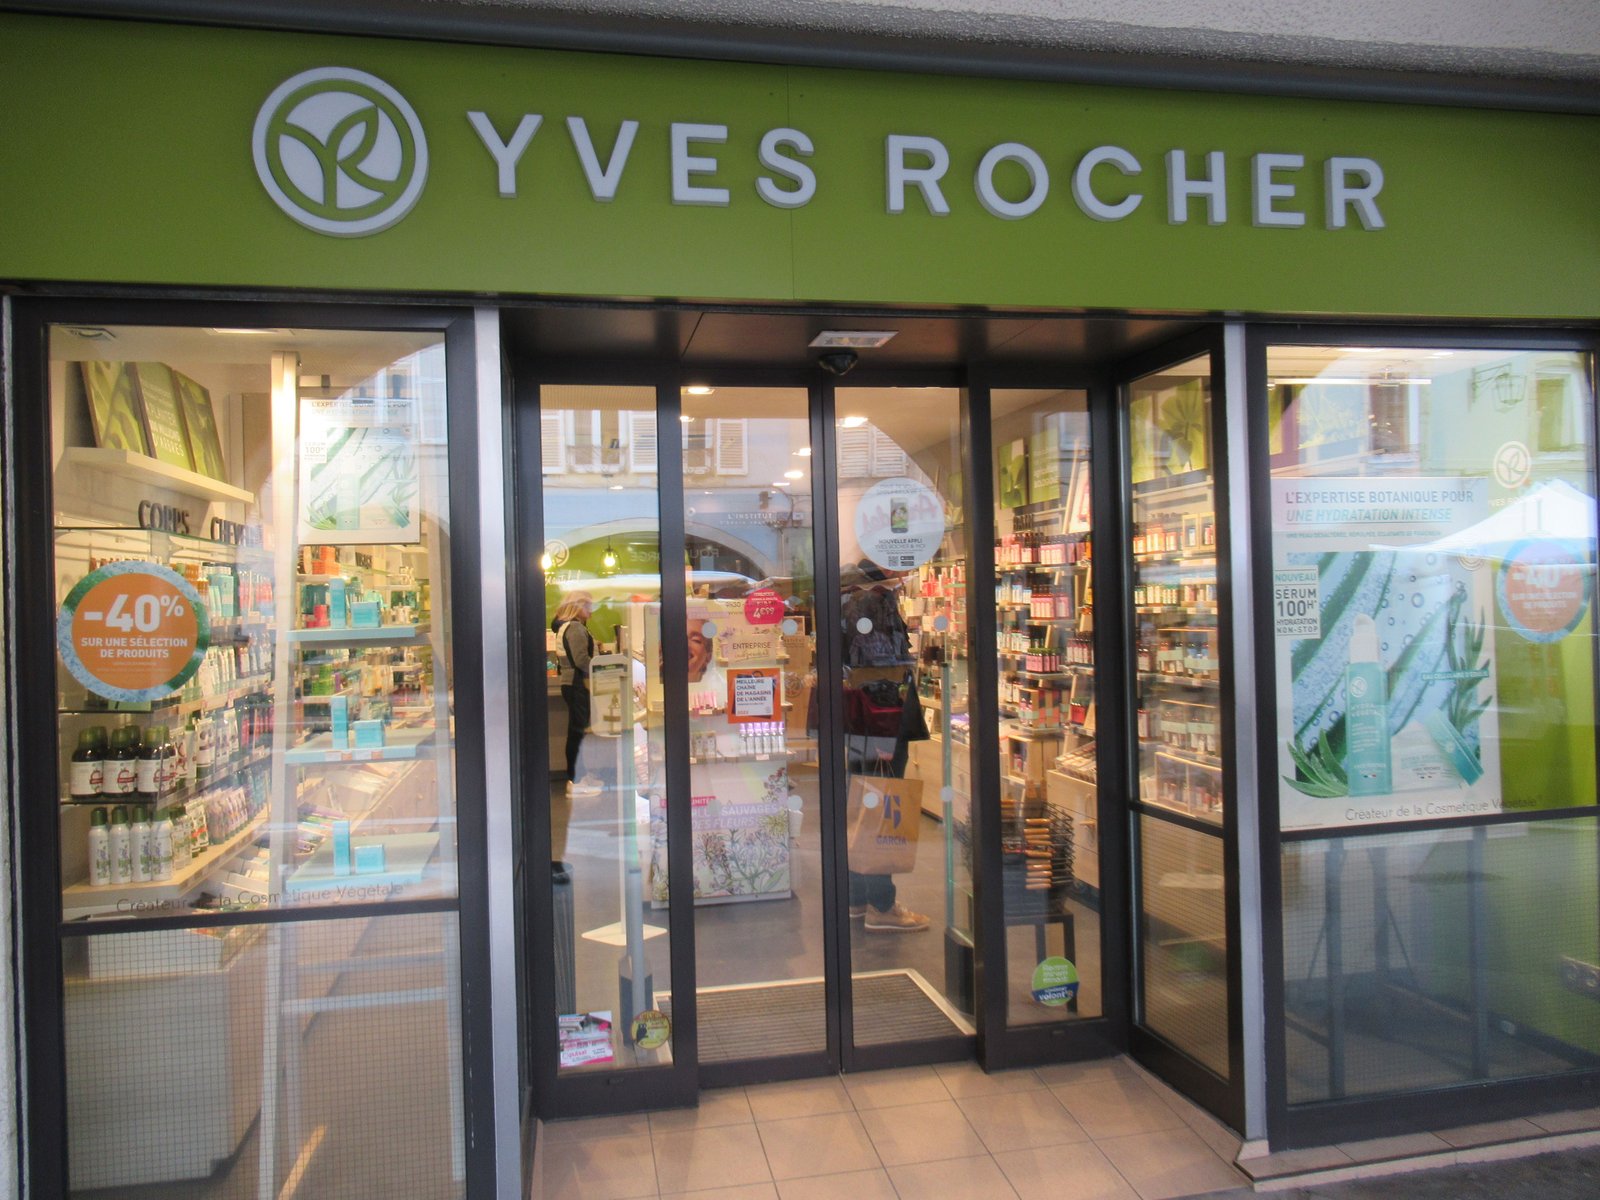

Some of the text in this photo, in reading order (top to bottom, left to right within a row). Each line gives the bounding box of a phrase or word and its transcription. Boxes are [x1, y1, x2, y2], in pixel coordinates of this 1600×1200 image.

[466, 111, 1385, 231] YVES ROCHER
[1286, 490, 1474, 504] L'EXPERTISE BOTANIQUE POUR
[138, 500, 189, 535] CORPS
[1287, 507, 1452, 522] UNE HYDRATATION INTENSE
[1275, 573, 1317, 582] NOUVEAU
[1275, 586, 1317, 600] SÉRUM
[84, 594, 184, 632] -40%
[1276, 618, 1318, 626] HYDRATATION
[1276, 626, 1318, 634] NON-STOP
[81, 635, 188, 647] SUR UNE SÉLECTION
[732, 642, 771, 650] ENTREPRISE
[101, 648, 169, 658] DE PRODUITS
[721, 804, 778, 816] SAUVAGES
[1396, 805, 1409, 817] de
[1413, 804, 1422, 816] la
[715, 817, 754, 829] FLEURS
[219, 893, 232, 906] la
